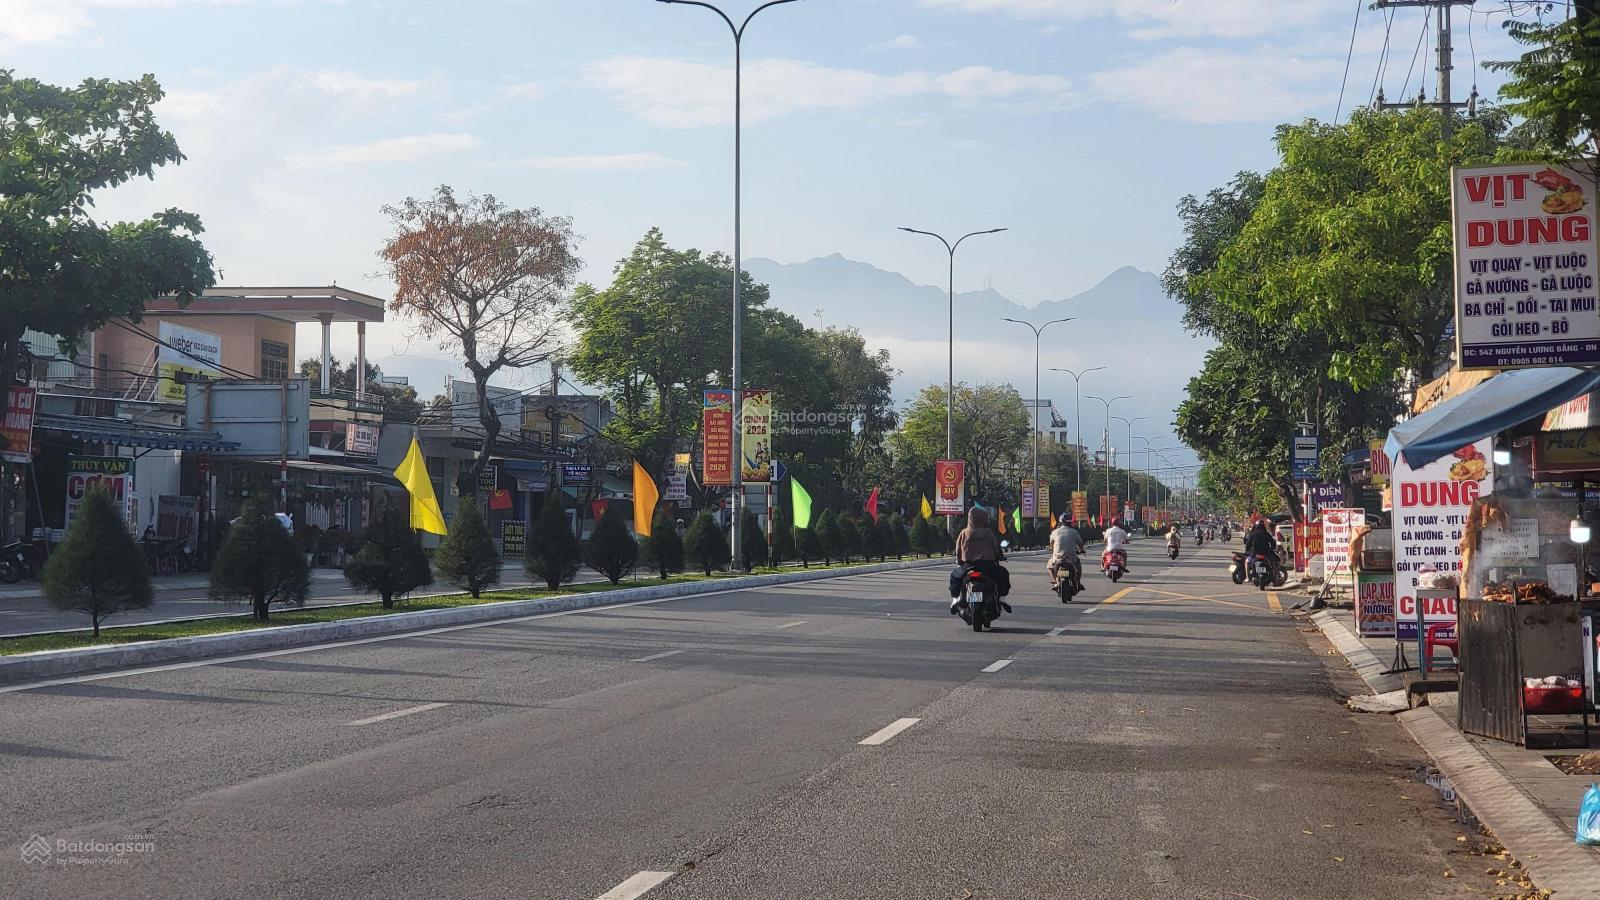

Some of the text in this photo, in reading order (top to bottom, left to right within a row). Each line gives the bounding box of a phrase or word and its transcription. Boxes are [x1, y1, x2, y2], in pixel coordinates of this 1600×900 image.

[1463, 173, 1531, 208] VỊT
[1466, 215, 1590, 248] DUNG
[1470, 259, 1488, 276] VỊT
[1492, 258, 1521, 273] QUAY
[1533, 256, 1552, 273] VỊT
[1555, 251, 1587, 272] LUỘC
[1466, 277, 1483, 295] GÀ
[1486, 275, 1529, 294] NƯỚNG
[1541, 273, 1557, 291] GÀ
[1561, 272, 1592, 293] LUỘC
[1465, 303, 1481, 316] BA
[1485, 297, 1505, 315] CHỈ
[1550, 299, 1568, 312] TAI
[1492, 318, 1512, 337] GỎI
[1516, 322, 1539, 336] HEO
[1479, 348, 1494, 356] 542
[747, 425, 767, 435] 2026
[709, 463, 726, 471] 2026
[1320, 484, 1342, 498] ĐIỆN
[1401, 481, 1479, 507] DUNG
[1403, 515, 1415, 527] VỊT
[1418, 515, 1438, 526] QUAY
[1446, 514, 1459, 526] VỊT
[1401, 531, 1412, 541] GÀ
[1405, 543, 1421, 556] TIẾT
[1424, 546, 1446, 556] CANH
[1397, 559, 1411, 572] GỎI
